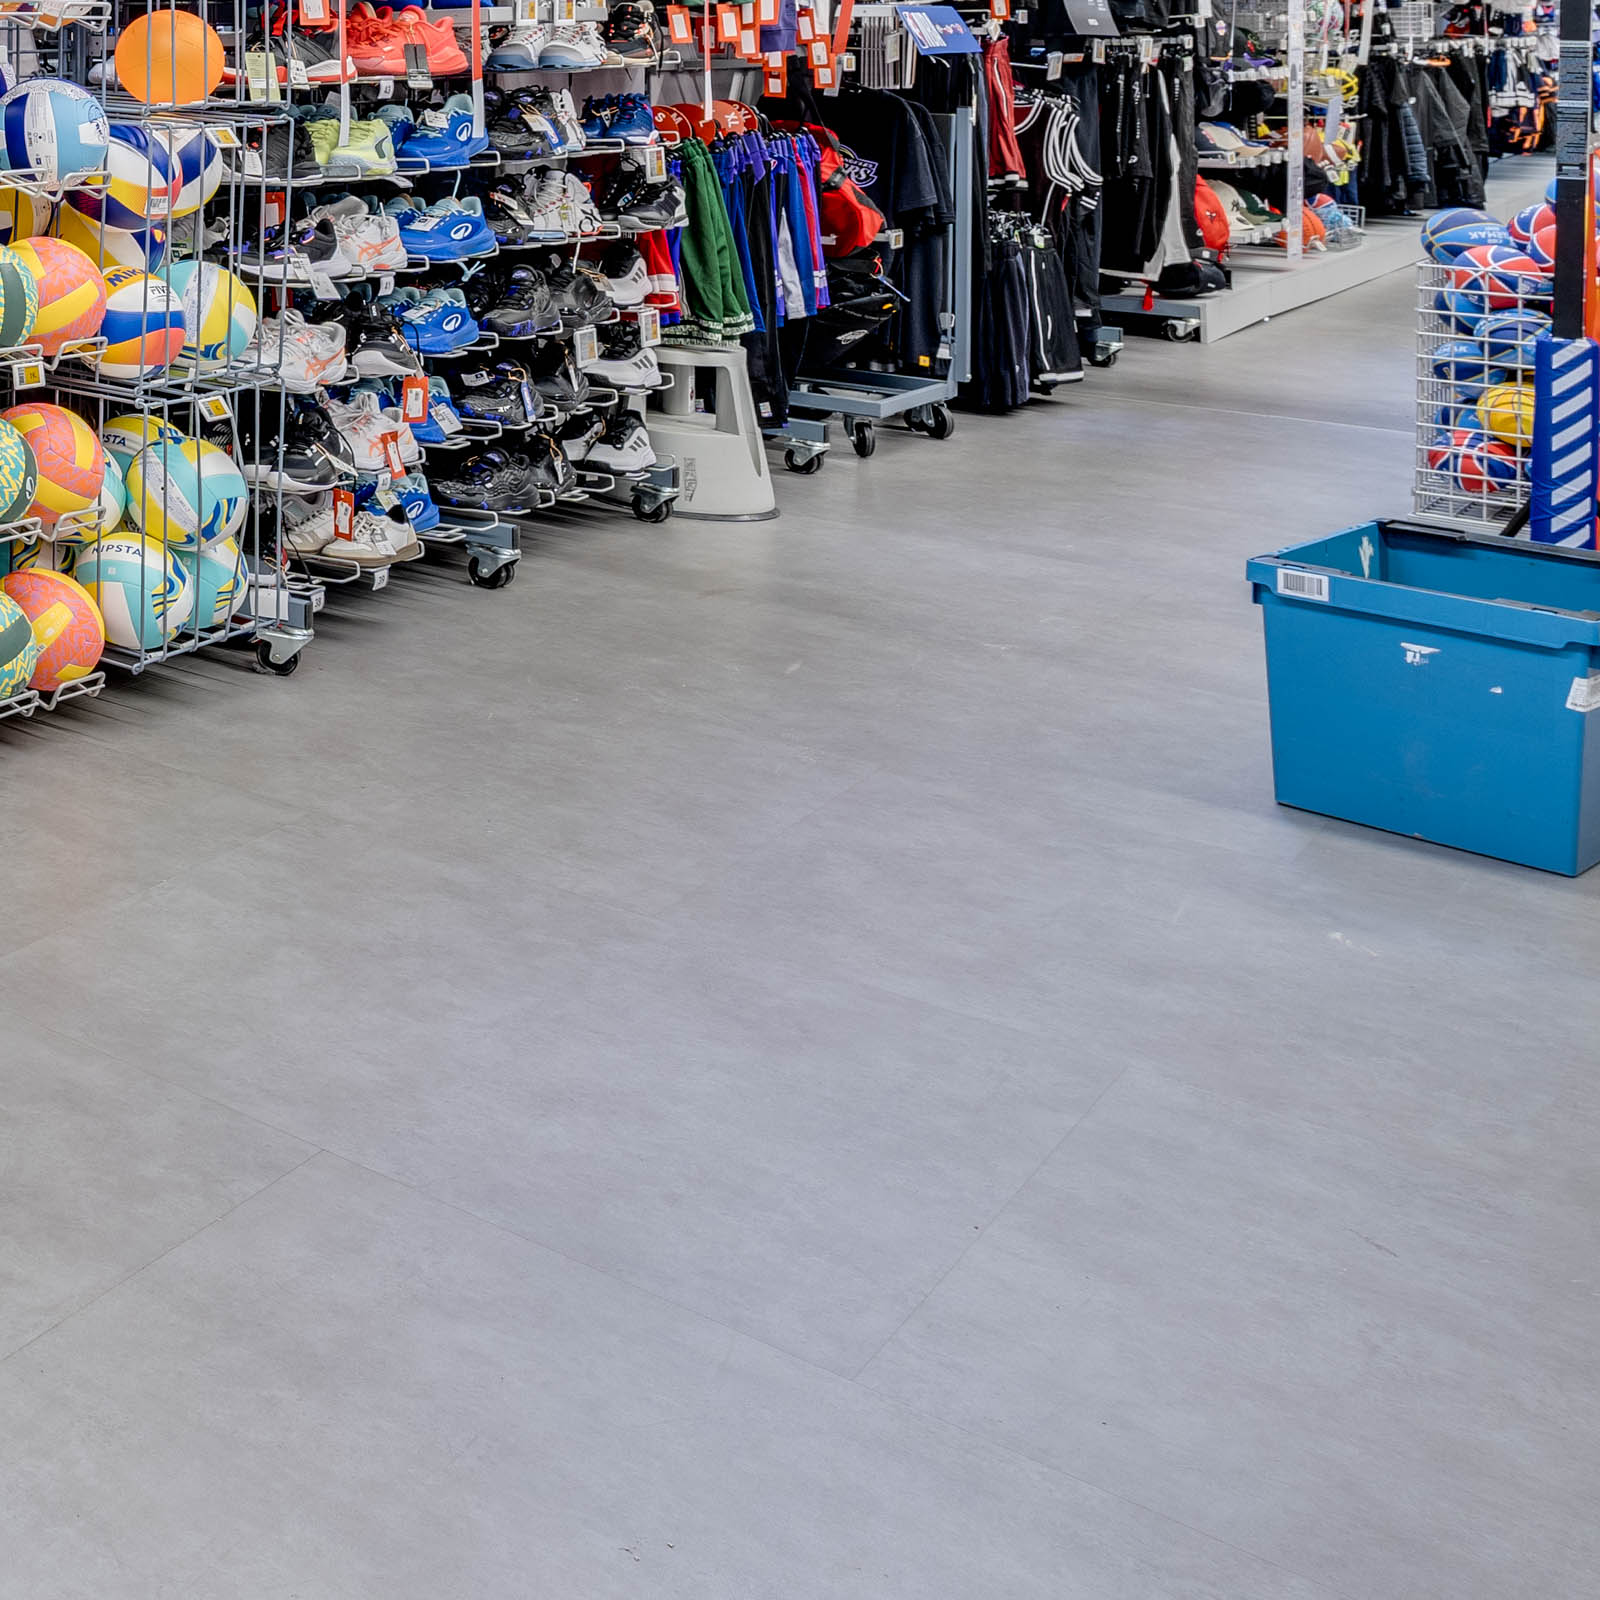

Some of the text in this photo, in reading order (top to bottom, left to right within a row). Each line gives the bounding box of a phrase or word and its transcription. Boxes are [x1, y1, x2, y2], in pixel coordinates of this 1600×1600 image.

[655, 112, 666, 123] S
[671, 111, 682, 126] M
[724, 111, 739, 129] XL
[102, 433, 126, 447] STA
